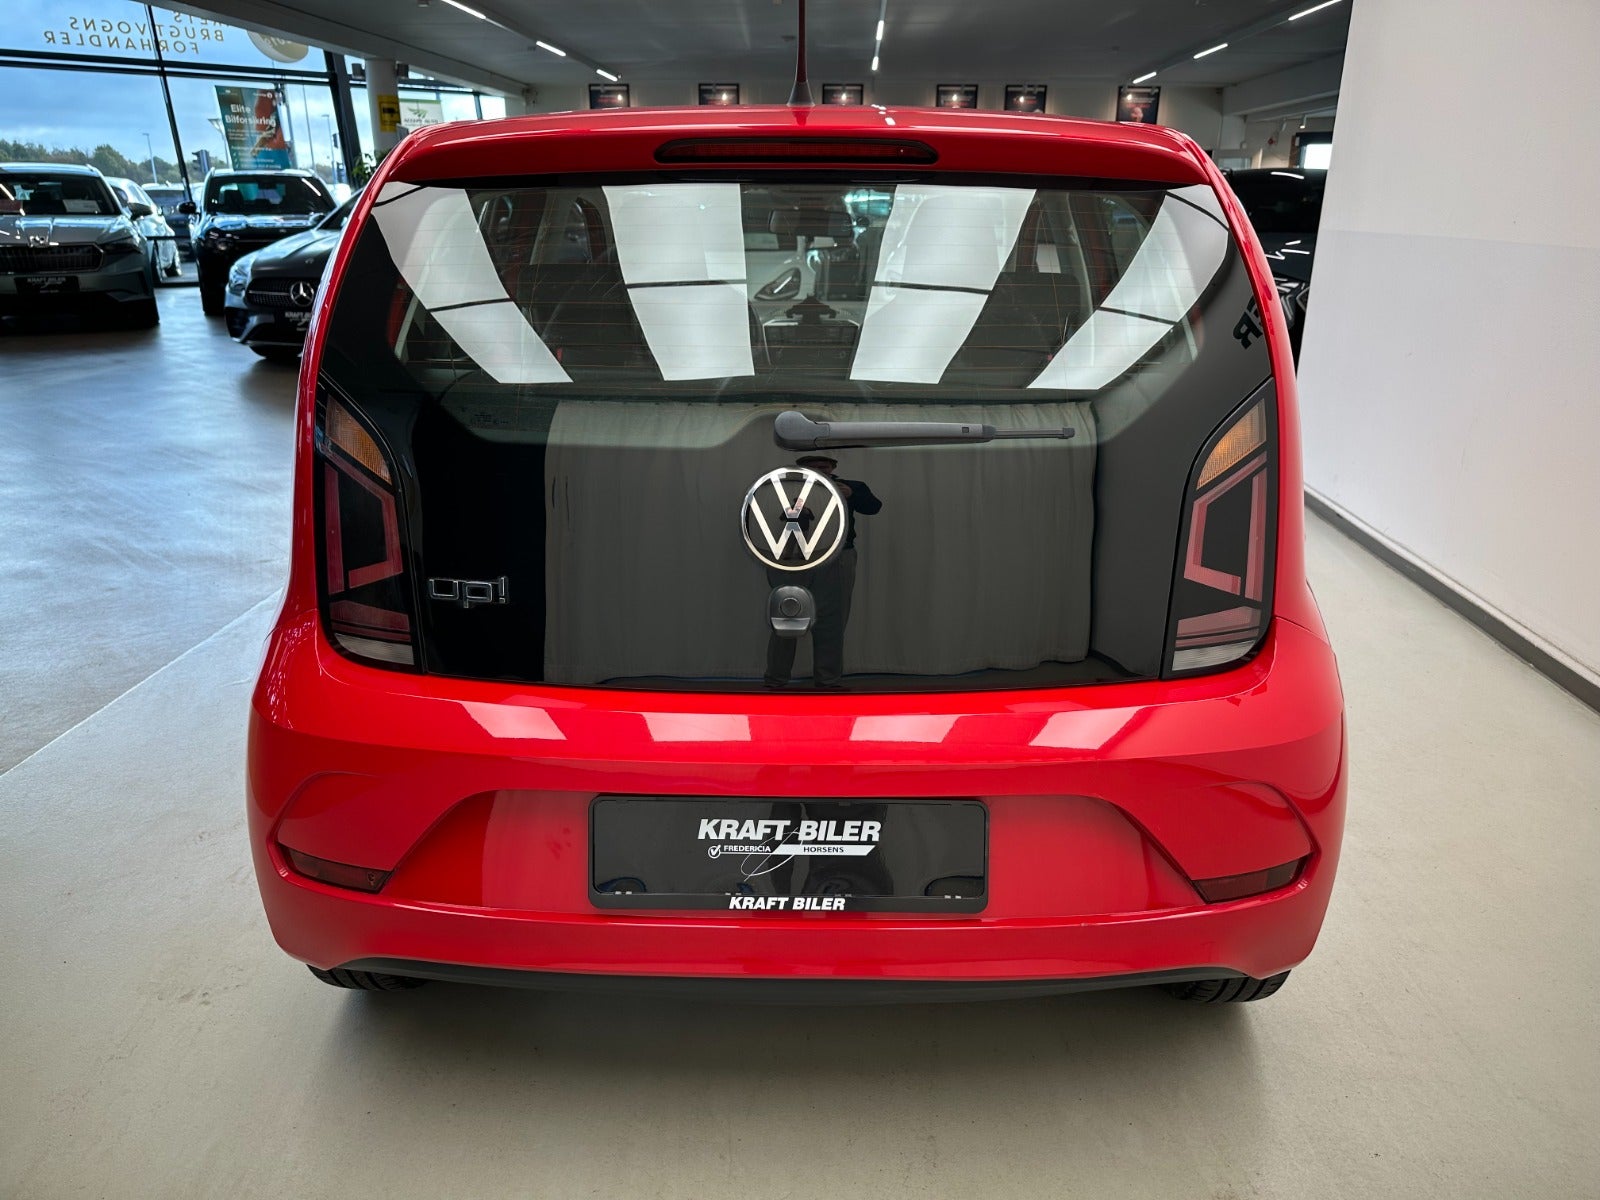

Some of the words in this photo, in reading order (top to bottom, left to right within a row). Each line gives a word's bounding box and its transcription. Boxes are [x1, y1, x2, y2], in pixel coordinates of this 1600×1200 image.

[230, 104, 251, 113] Elite
[225, 115, 276, 127] Bilforsikring
[429, 576, 507, 608] up!
[698, 818, 791, 840] KRAFT
[798, 820, 882, 842] BILER
[723, 845, 771, 853] FREDERICIA
[728, 896, 790, 910] KRAFT
[792, 897, 846, 911] BILER
